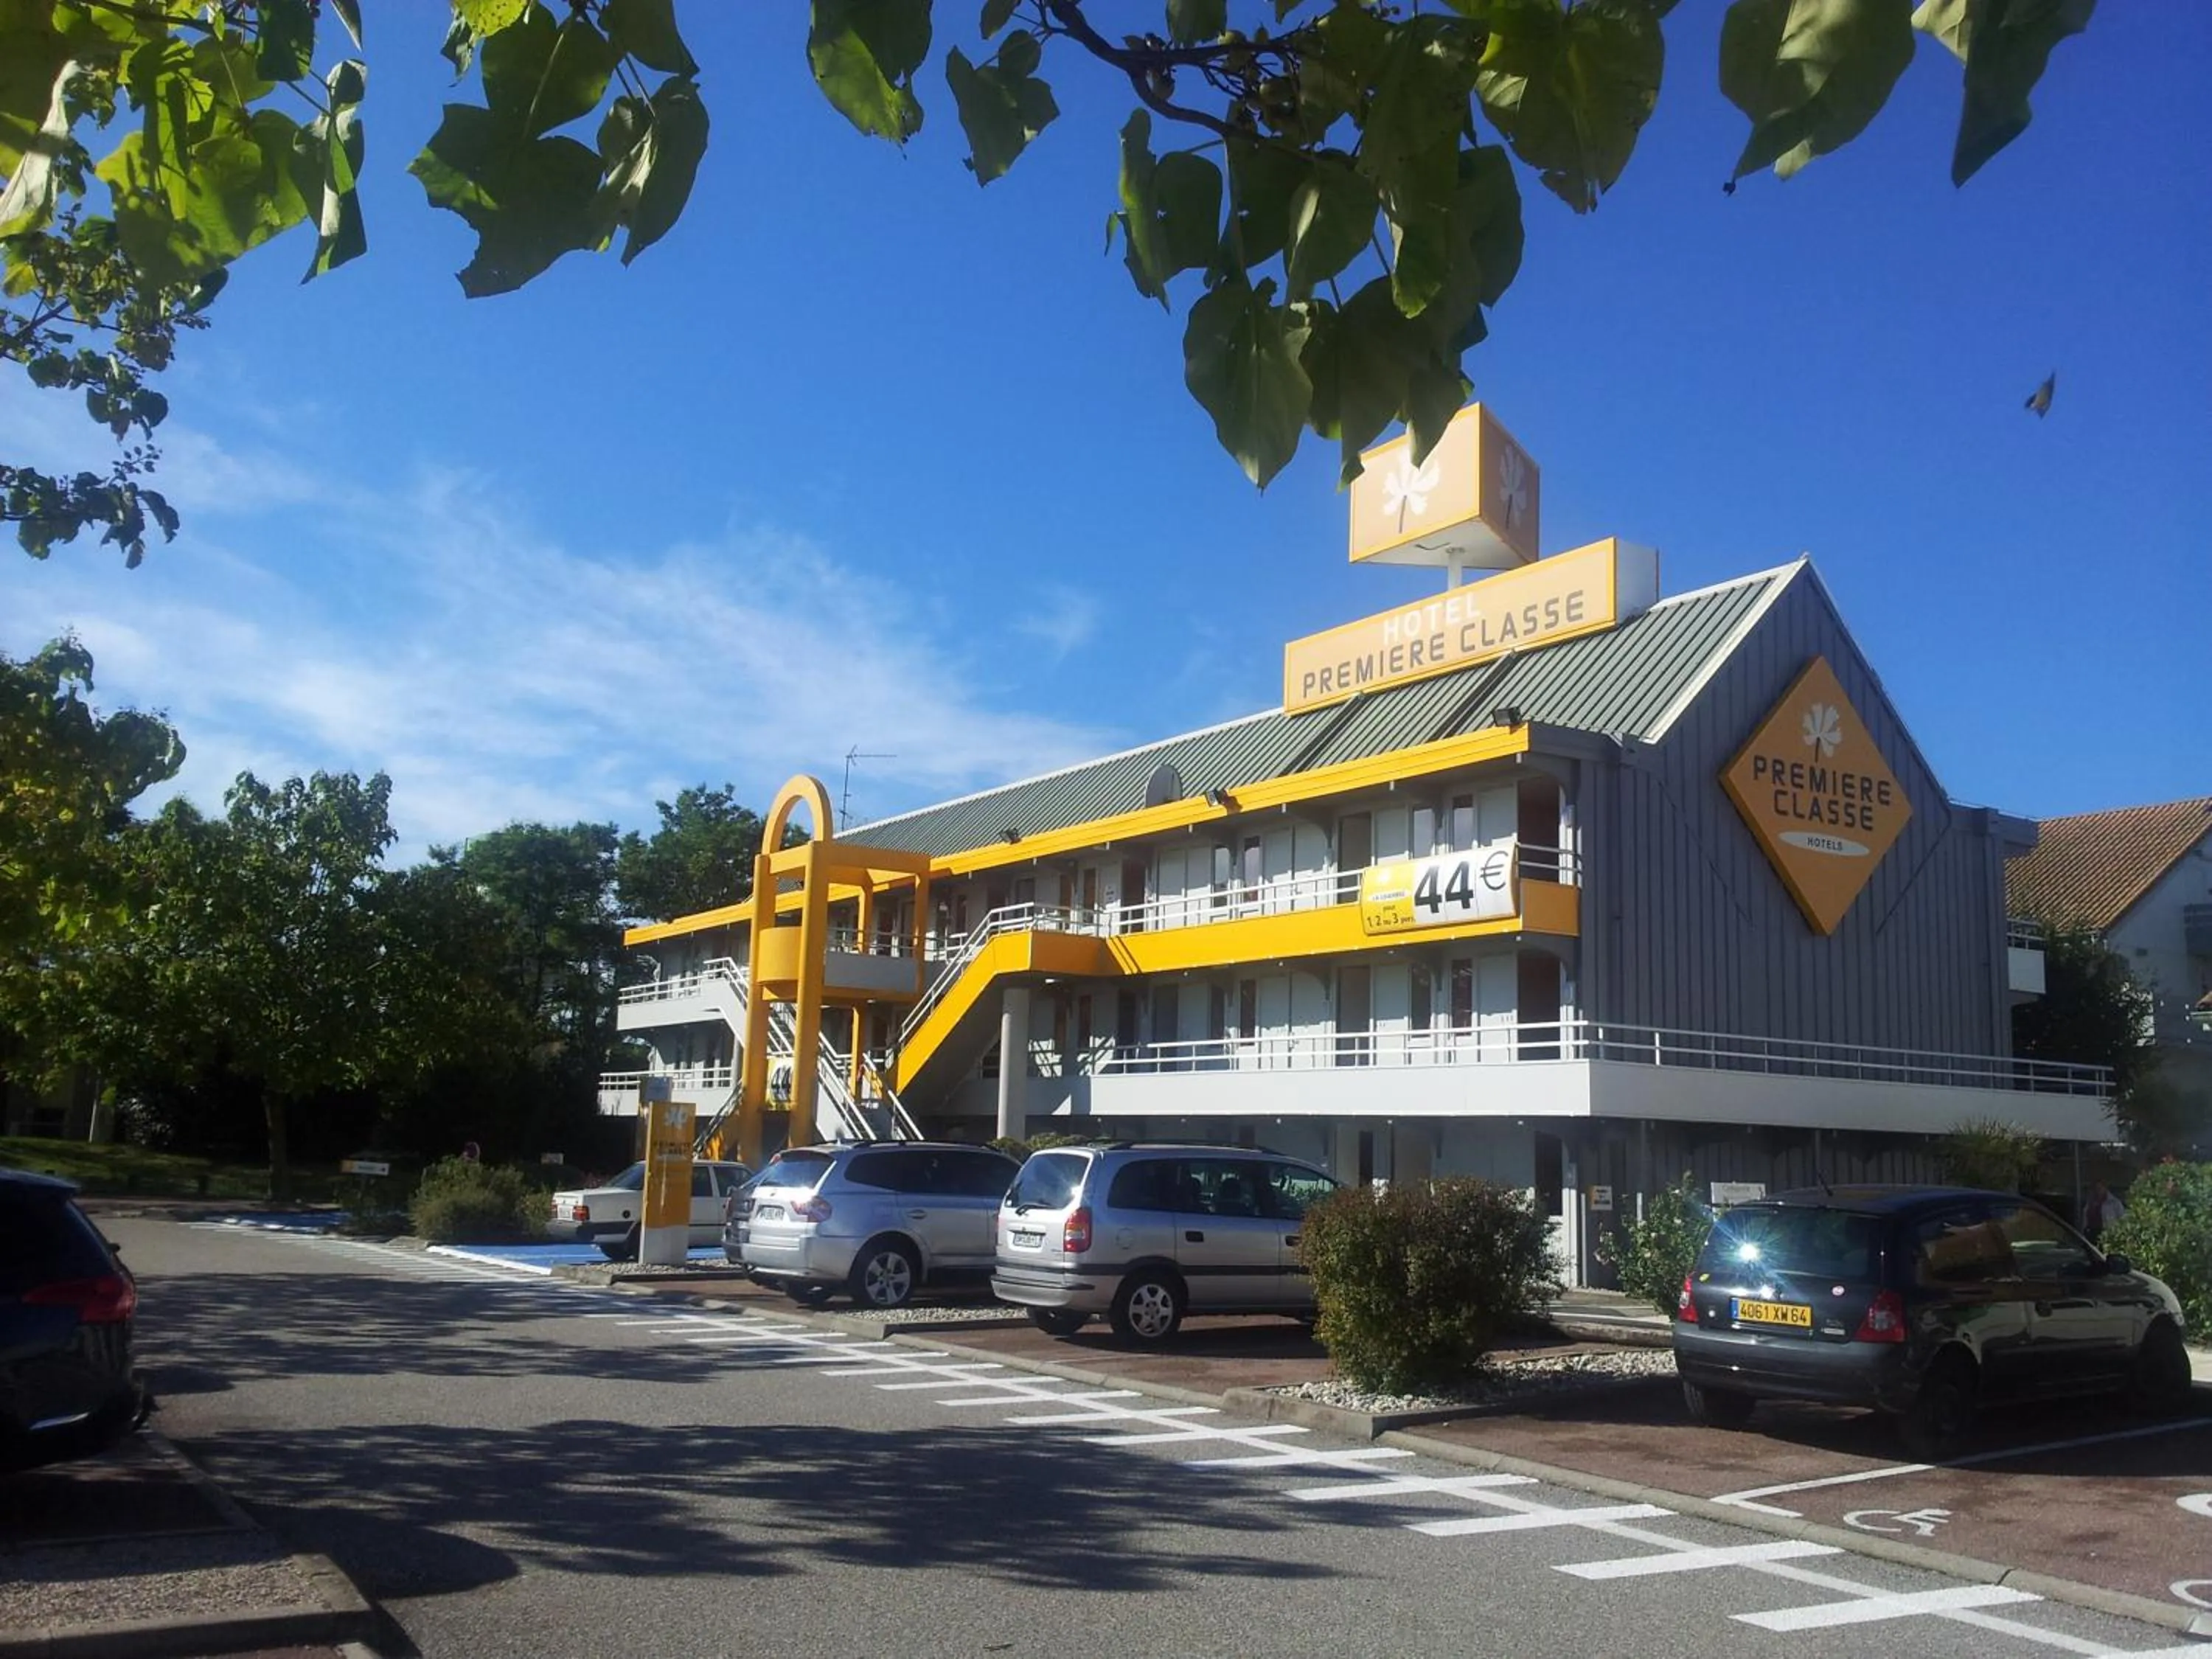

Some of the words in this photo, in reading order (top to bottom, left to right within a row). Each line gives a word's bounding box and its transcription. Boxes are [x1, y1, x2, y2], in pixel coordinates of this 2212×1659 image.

[1383, 592, 1481, 644] HOTEL
[1303, 633, 1445, 698] PREMIERE
[1460, 590, 1585, 653] CLASSE
[1753, 755, 1891, 806] PREMIERE
[1773, 789, 1874, 831] CLASSE
[1806, 836, 1843, 852] HOTELS
[1391, 911, 1399, 924] 3
[1740, 1303, 1769, 1319] 4061
[1773, 1307, 1788, 1322] XW
[1791, 1308, 1807, 1324] 64
